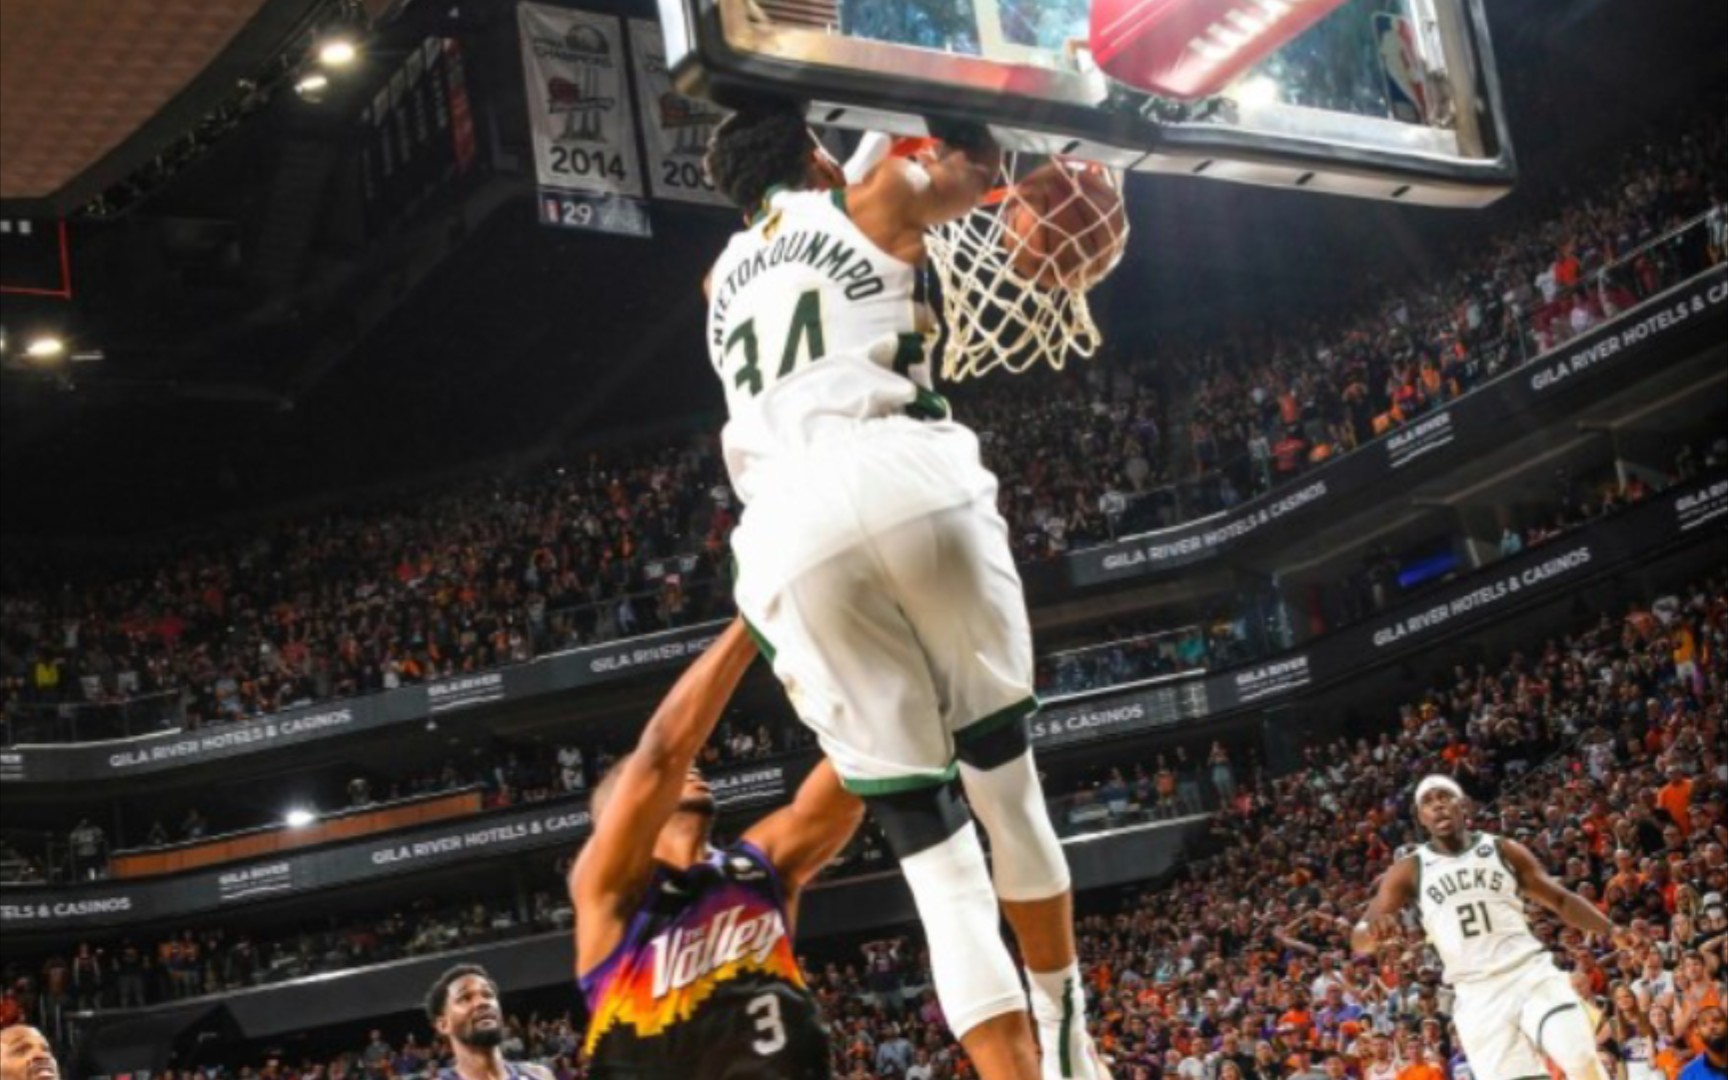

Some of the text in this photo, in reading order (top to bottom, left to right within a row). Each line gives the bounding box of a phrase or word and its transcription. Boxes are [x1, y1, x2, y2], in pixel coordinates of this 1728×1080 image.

[549, 146, 626, 180] 2014
[562, 201, 592, 225] 29
[1531, 363, 1570, 390] GILA
[1571, 336, 1622, 371] RIVER
[1623, 302, 1690, 346] HOTELS
[1692, 295, 1706, 312] &
[1102, 480, 1328, 570] GILA RIVER HOTELS & CASINOS
[1373, 547, 1592, 647] GILA RIVER HOTELS & CASINOS
[590, 655, 632, 673] GILA
[634, 643, 685, 664] RIVER
[109, 747, 150, 767] GILA
[152, 740, 198, 759] RIVER
[202, 727, 263, 752] HOTELS
[280, 709, 353, 735] CASINOS
[1050, 719, 1062, 735] &
[1066, 704, 1143, 729] CASINOS
[372, 848, 411, 864] GILA
[412, 835, 462, 857] RIVER
[464, 823, 528, 847] HOTELS
[529, 821, 541, 834] &
[1426, 867, 1505, 905] BUCKS
[38, 903, 50, 918] &
[53, 897, 131, 917] CASINOS
[1456, 900, 1493, 939] 21
[650, 904, 786, 999] Valley
[746, 992, 787, 1056] 3
